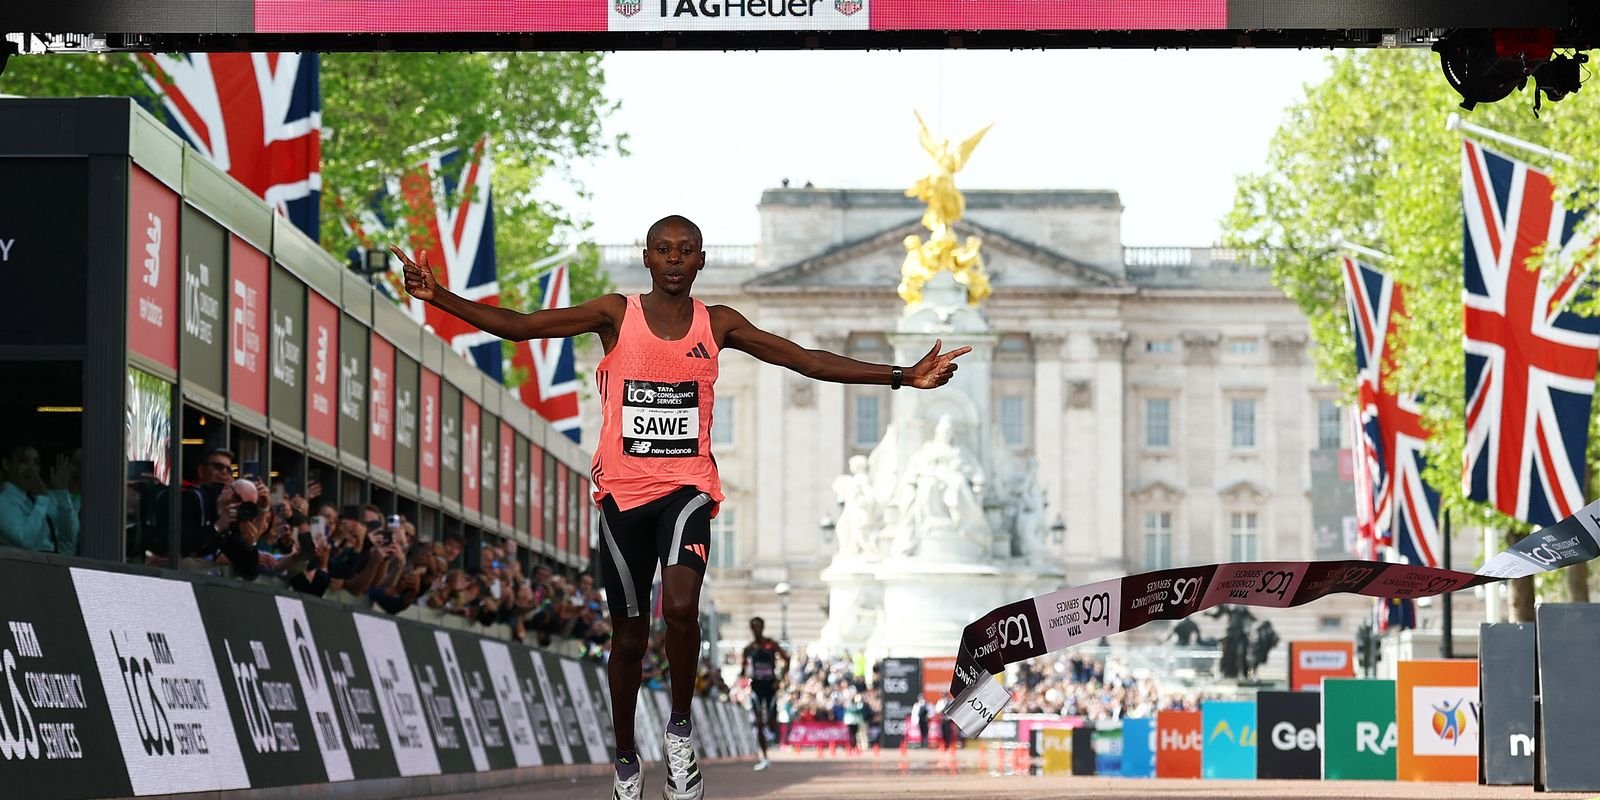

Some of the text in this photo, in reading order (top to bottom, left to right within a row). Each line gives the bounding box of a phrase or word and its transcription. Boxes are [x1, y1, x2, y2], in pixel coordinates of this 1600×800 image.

[627, 384, 655, 403] tcs
[633, 415, 689, 436] SAWE
[666, 446, 692, 455] balance
[1519, 543, 1562, 566] tcs
[1146, 578, 1172, 593] SERVICES
[1171, 576, 1204, 608] tcs
[1229, 589, 1249, 599] TATA
[1255, 570, 1294, 601] tcs
[1056, 598, 1080, 613] SERVICES
[1082, 592, 1110, 627] tcs
[1131, 592, 1168, 609] CONSULTANCY
[1149, 602, 1165, 615] TATA
[998, 613, 1034, 649] tcs
[1049, 611, 1080, 629] CONSULTANCY
[1067, 625, 1082, 637] TATA
[8, 621, 43, 658] TATA
[146, 632, 175, 665] TATA
[25, 672, 88, 709] CONSULTANCY
[109, 629, 175, 757] tcs
[38, 723, 83, 759] SERVICES
